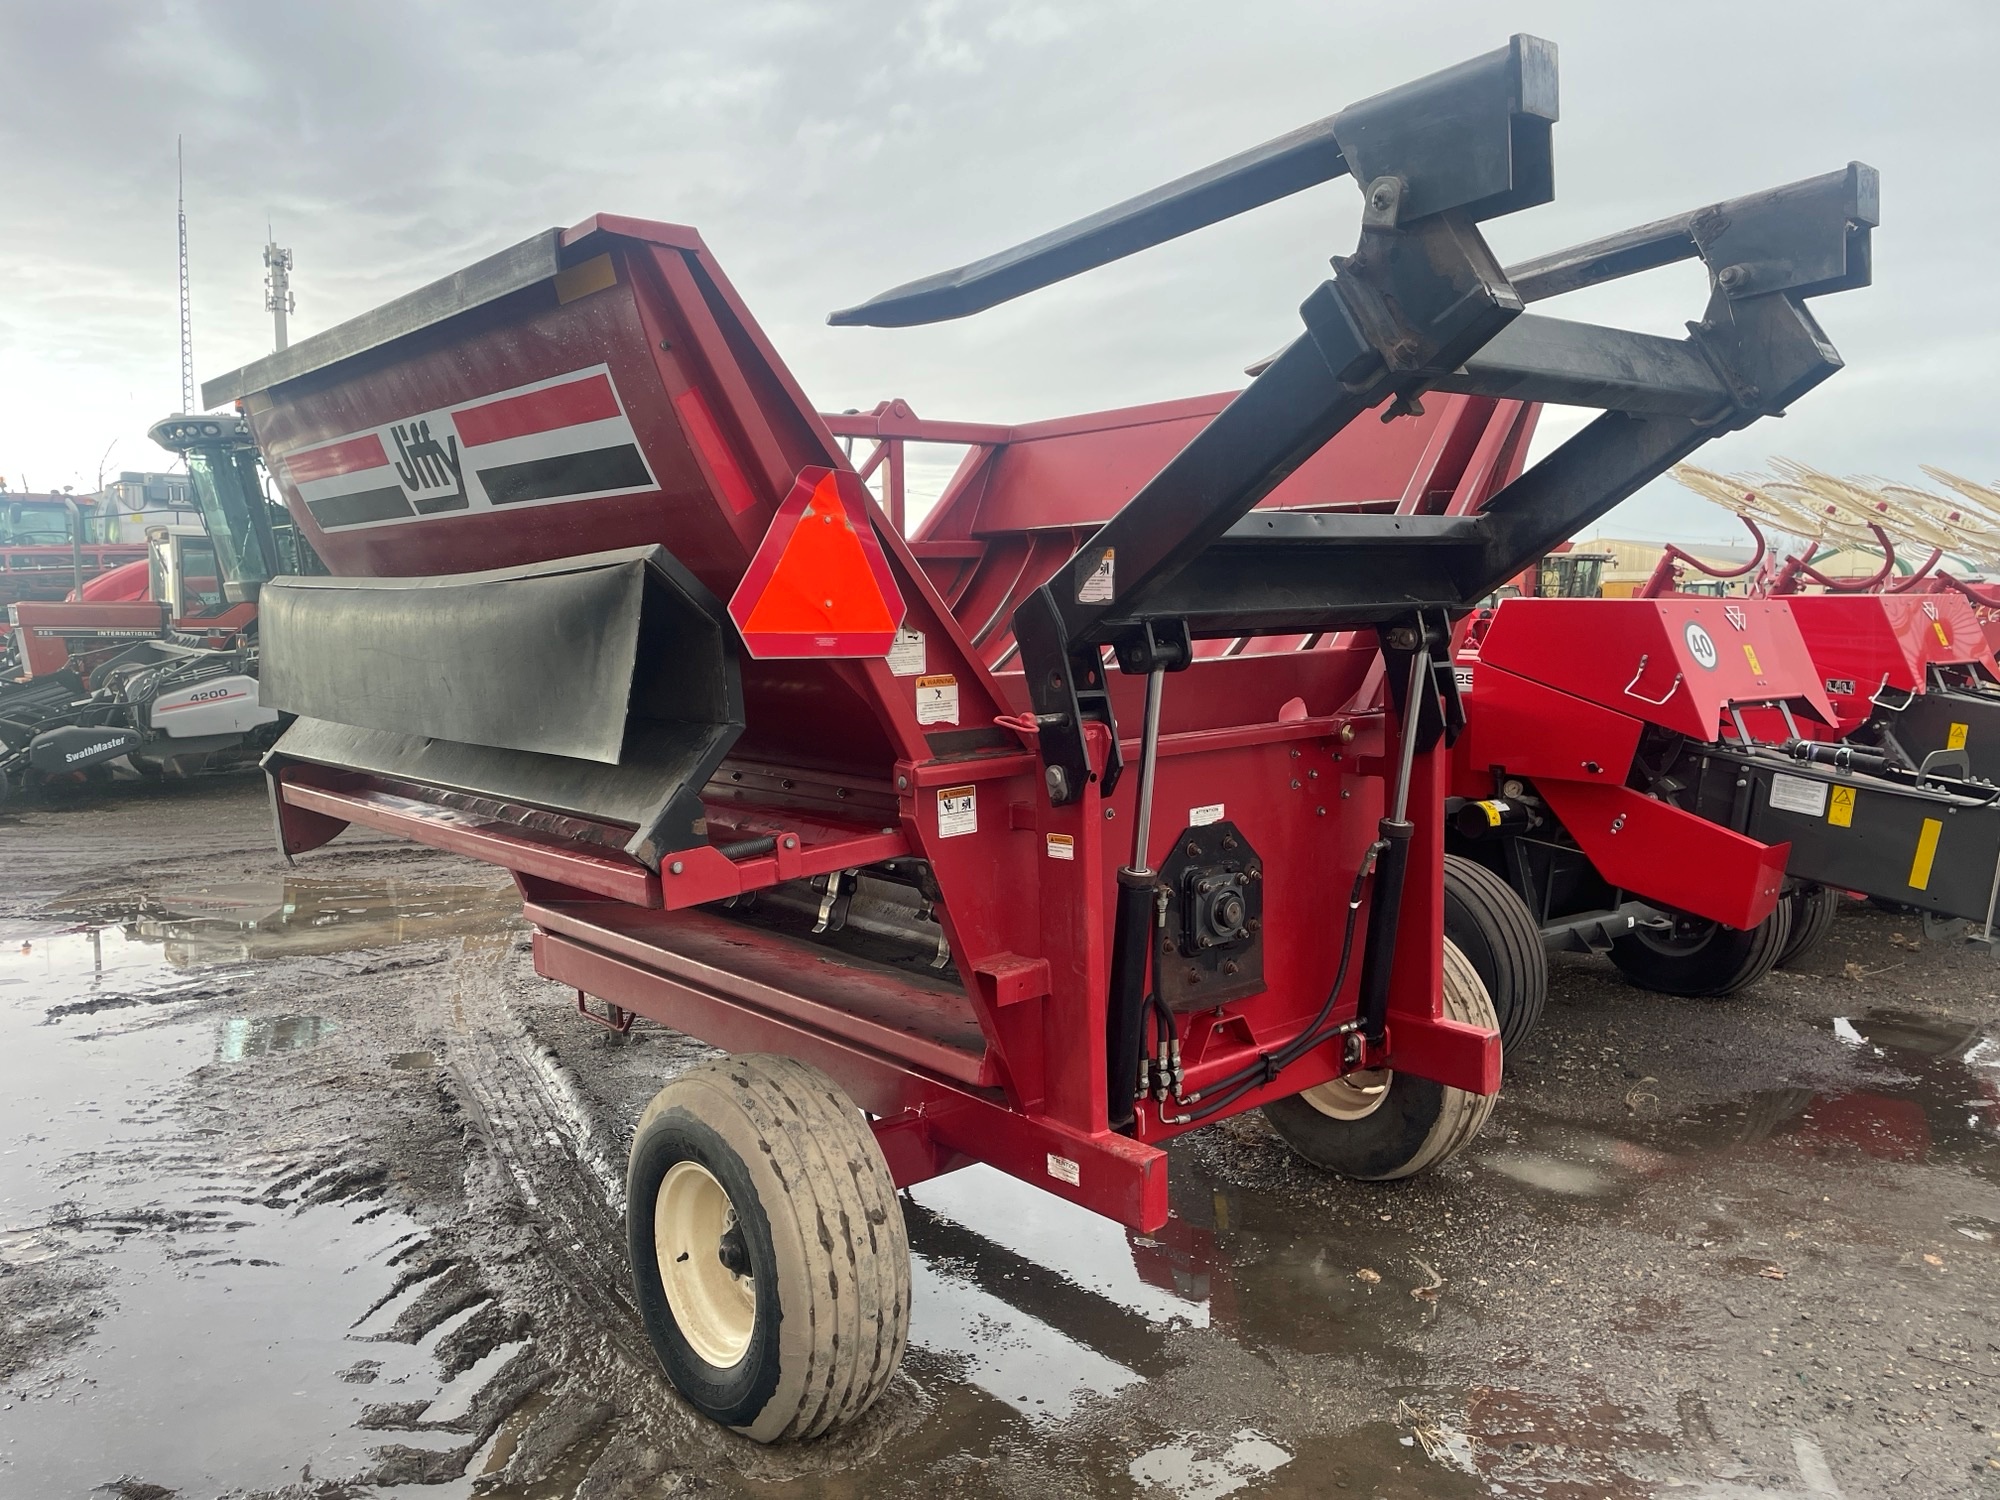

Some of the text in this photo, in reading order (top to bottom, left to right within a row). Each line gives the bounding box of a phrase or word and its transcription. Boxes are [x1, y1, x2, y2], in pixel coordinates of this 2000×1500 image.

[1692, 634, 1712, 658] 40
[190, 688, 228, 702] 4200
[65, 735, 125, 763] SwathMaster
